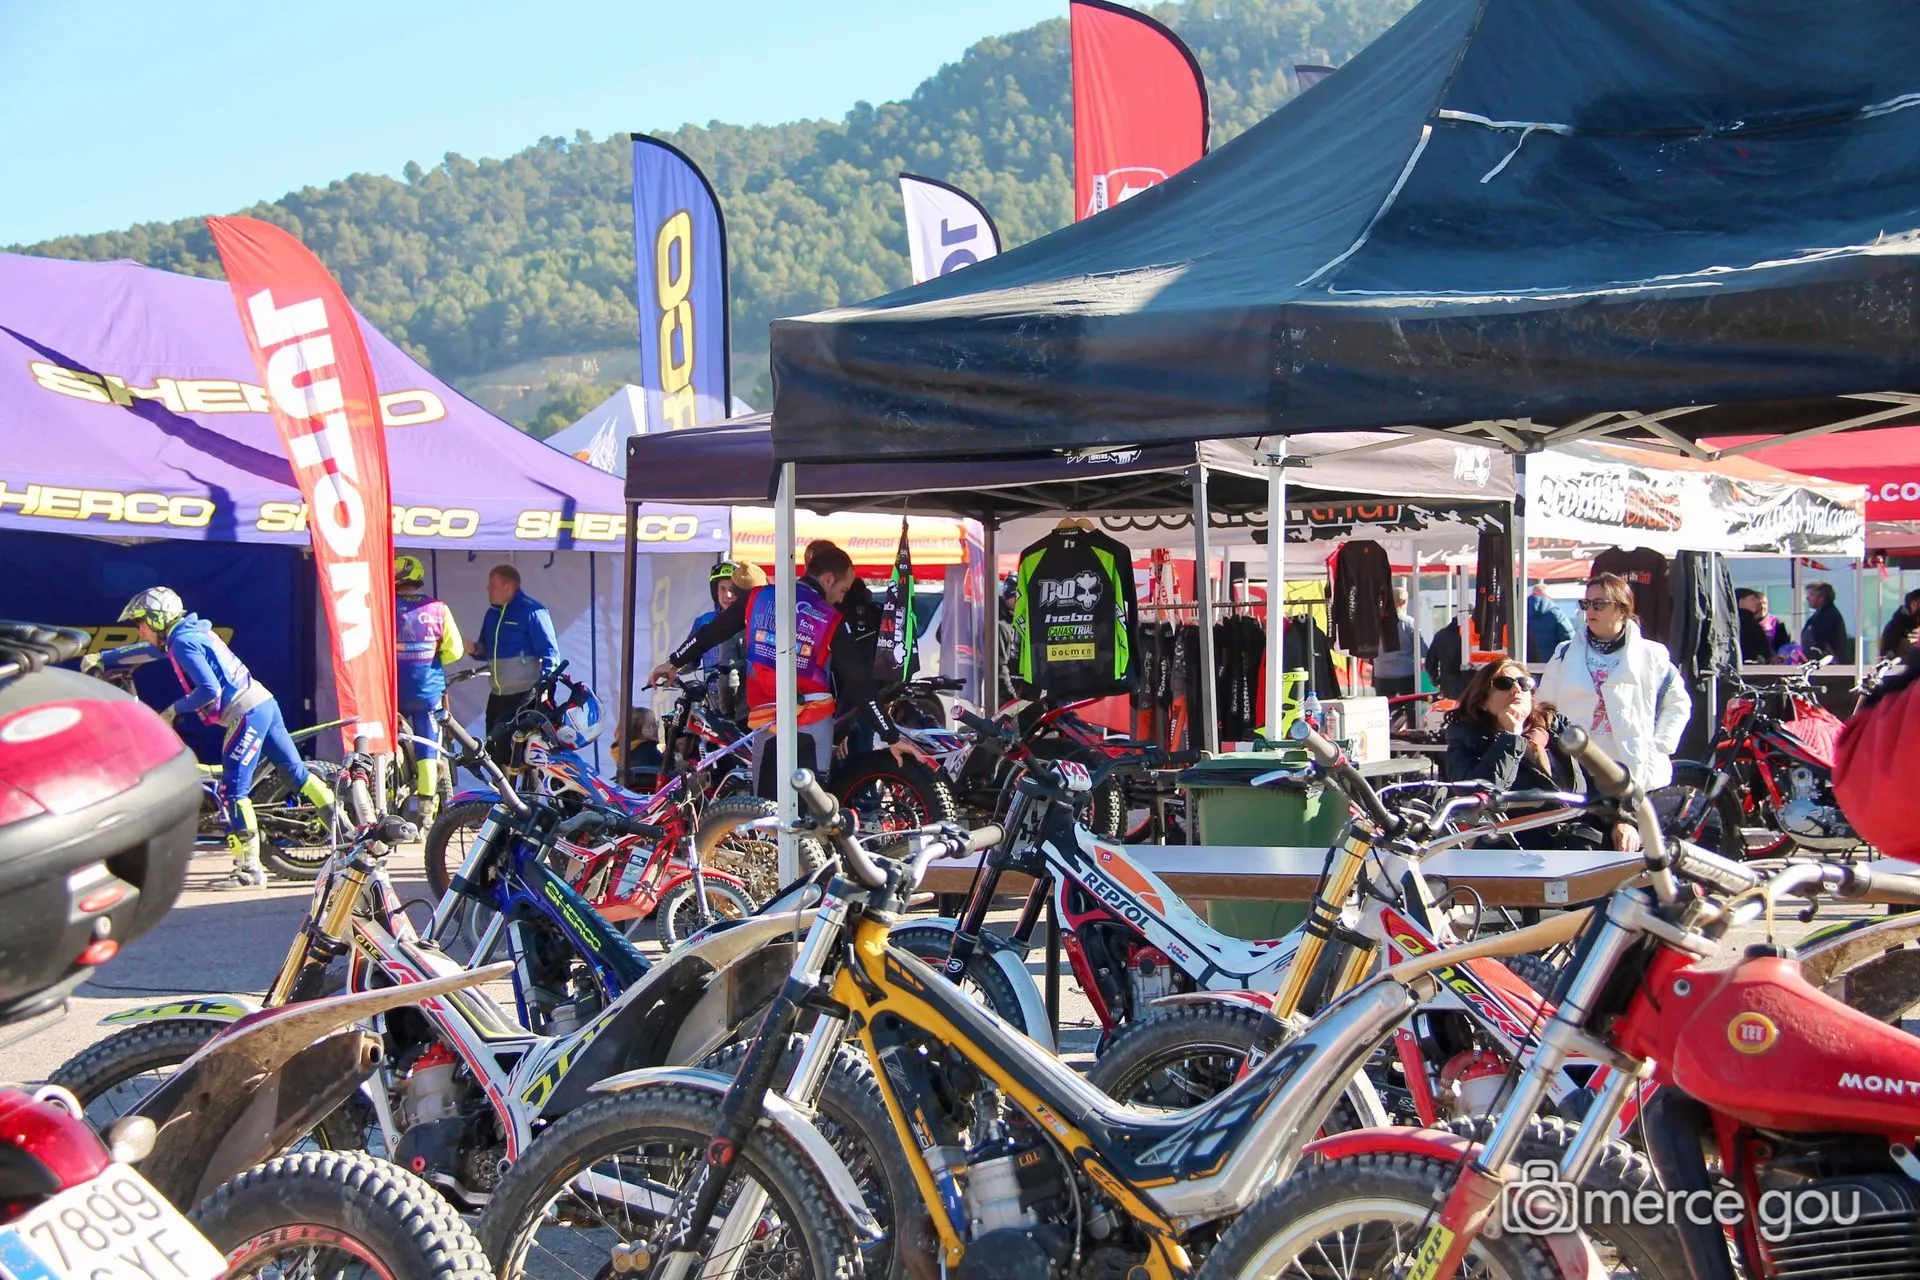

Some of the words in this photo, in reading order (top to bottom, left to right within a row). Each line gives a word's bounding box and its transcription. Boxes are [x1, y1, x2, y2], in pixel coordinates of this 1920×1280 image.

[27, 360, 446, 427] SHEO
[735, 532, 775, 546] Hond
[1044, 613, 1094, 623] hebo
[868, 700, 889, 731] hebo
[230, 726, 258, 760] KENNY
[1082, 872, 1149, 930] REPSOL
[30, 1177, 162, 1272] 7899
